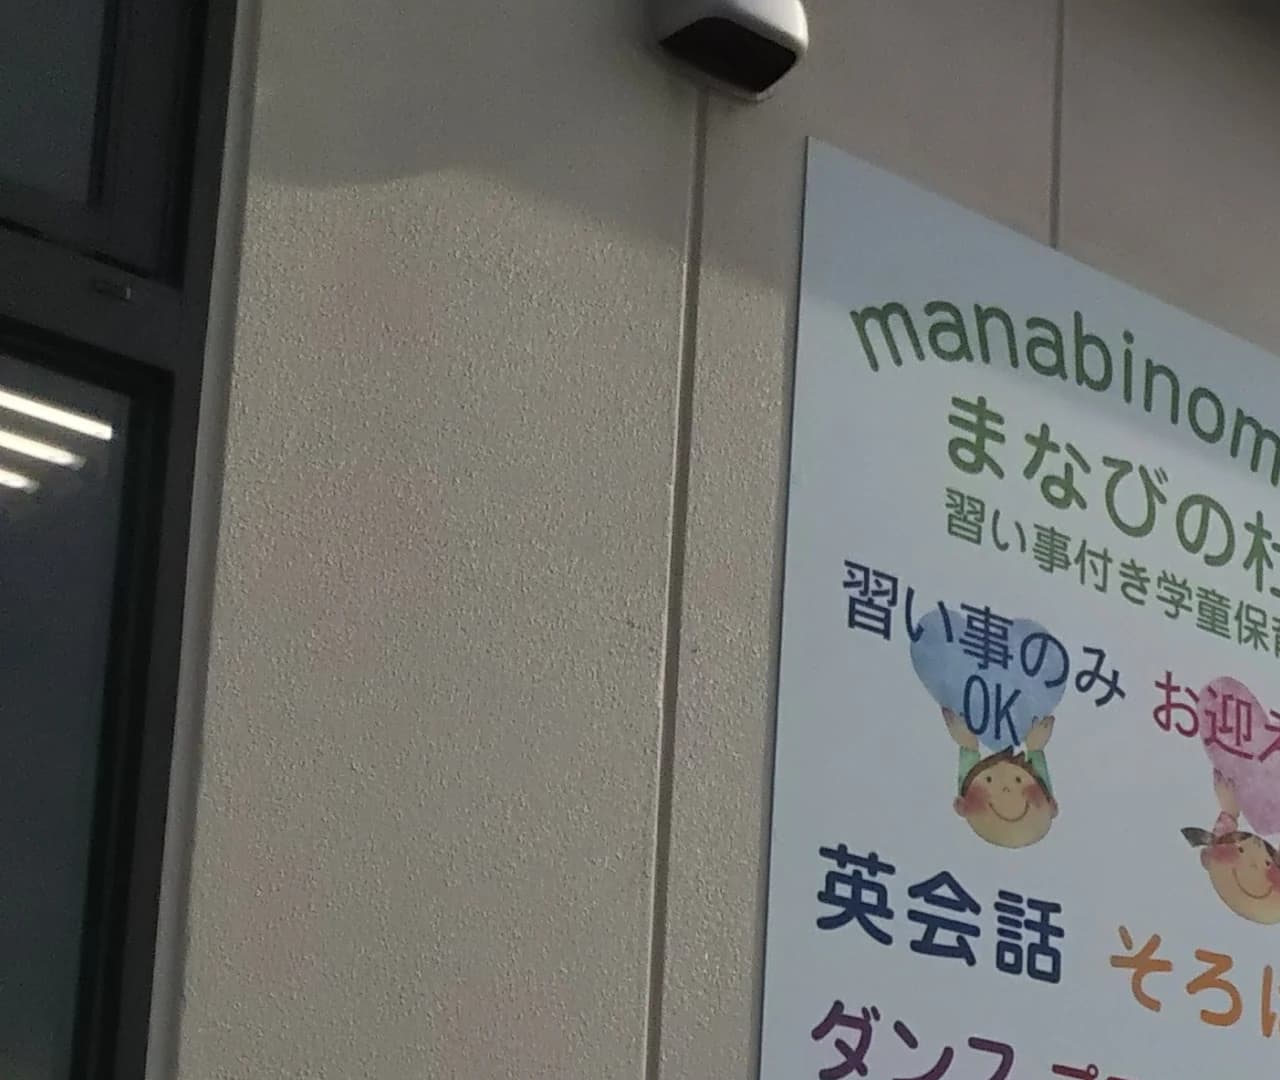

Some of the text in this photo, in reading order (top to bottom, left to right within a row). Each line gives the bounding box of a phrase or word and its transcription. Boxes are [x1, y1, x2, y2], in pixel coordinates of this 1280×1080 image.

[842, 559, 1126, 707] 習い事のみ
[962, 673, 1022, 748] OK
[816, 843, 1065, 984] 英会話
